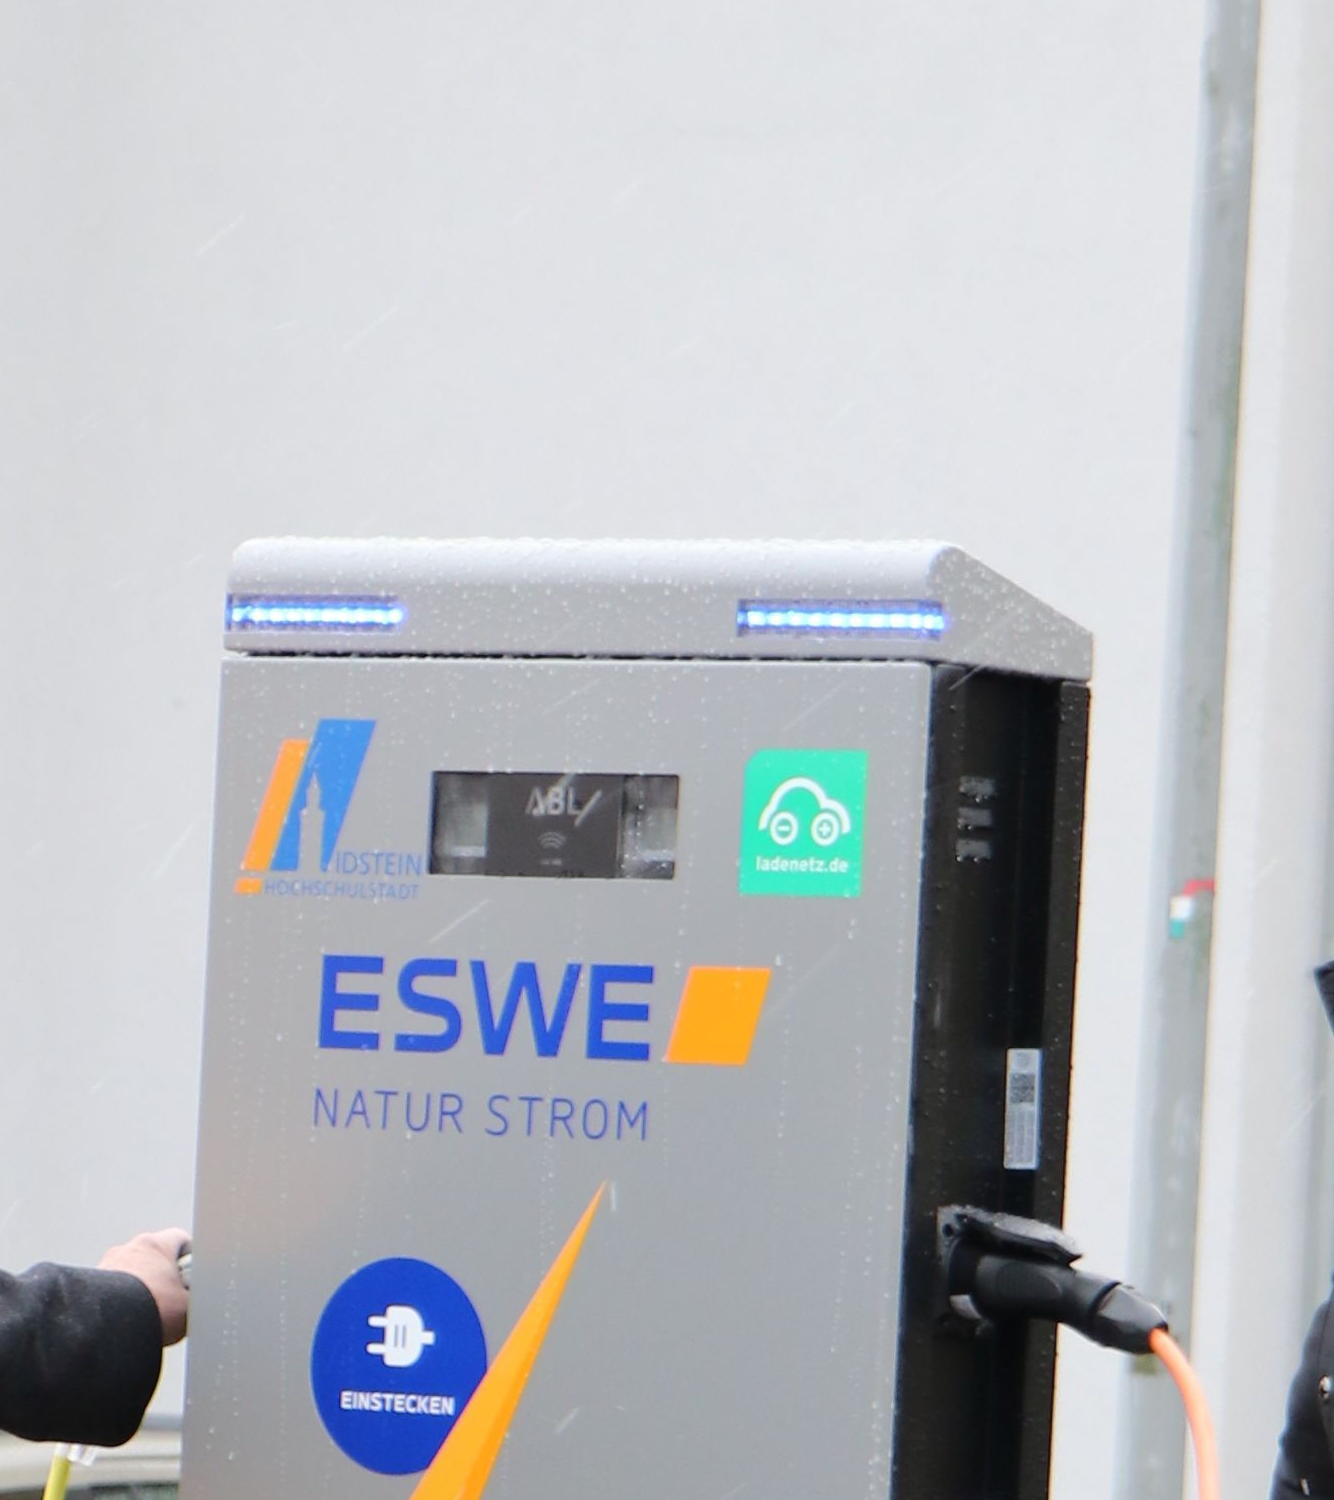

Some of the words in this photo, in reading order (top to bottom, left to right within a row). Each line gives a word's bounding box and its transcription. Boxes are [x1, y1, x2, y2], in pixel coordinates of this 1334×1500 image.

[334, 851, 423, 877] IDSTEIN
[755, 855, 850, 874] ladenetz.de
[264, 878, 420, 900] HOCHSCHULSTADT
[316, 952, 657, 1063] ESWE
[312, 1086, 467, 1134] NATUR
[484, 1094, 650, 1142] STROM
[339, 1390, 456, 1417] EINSTECKEN
